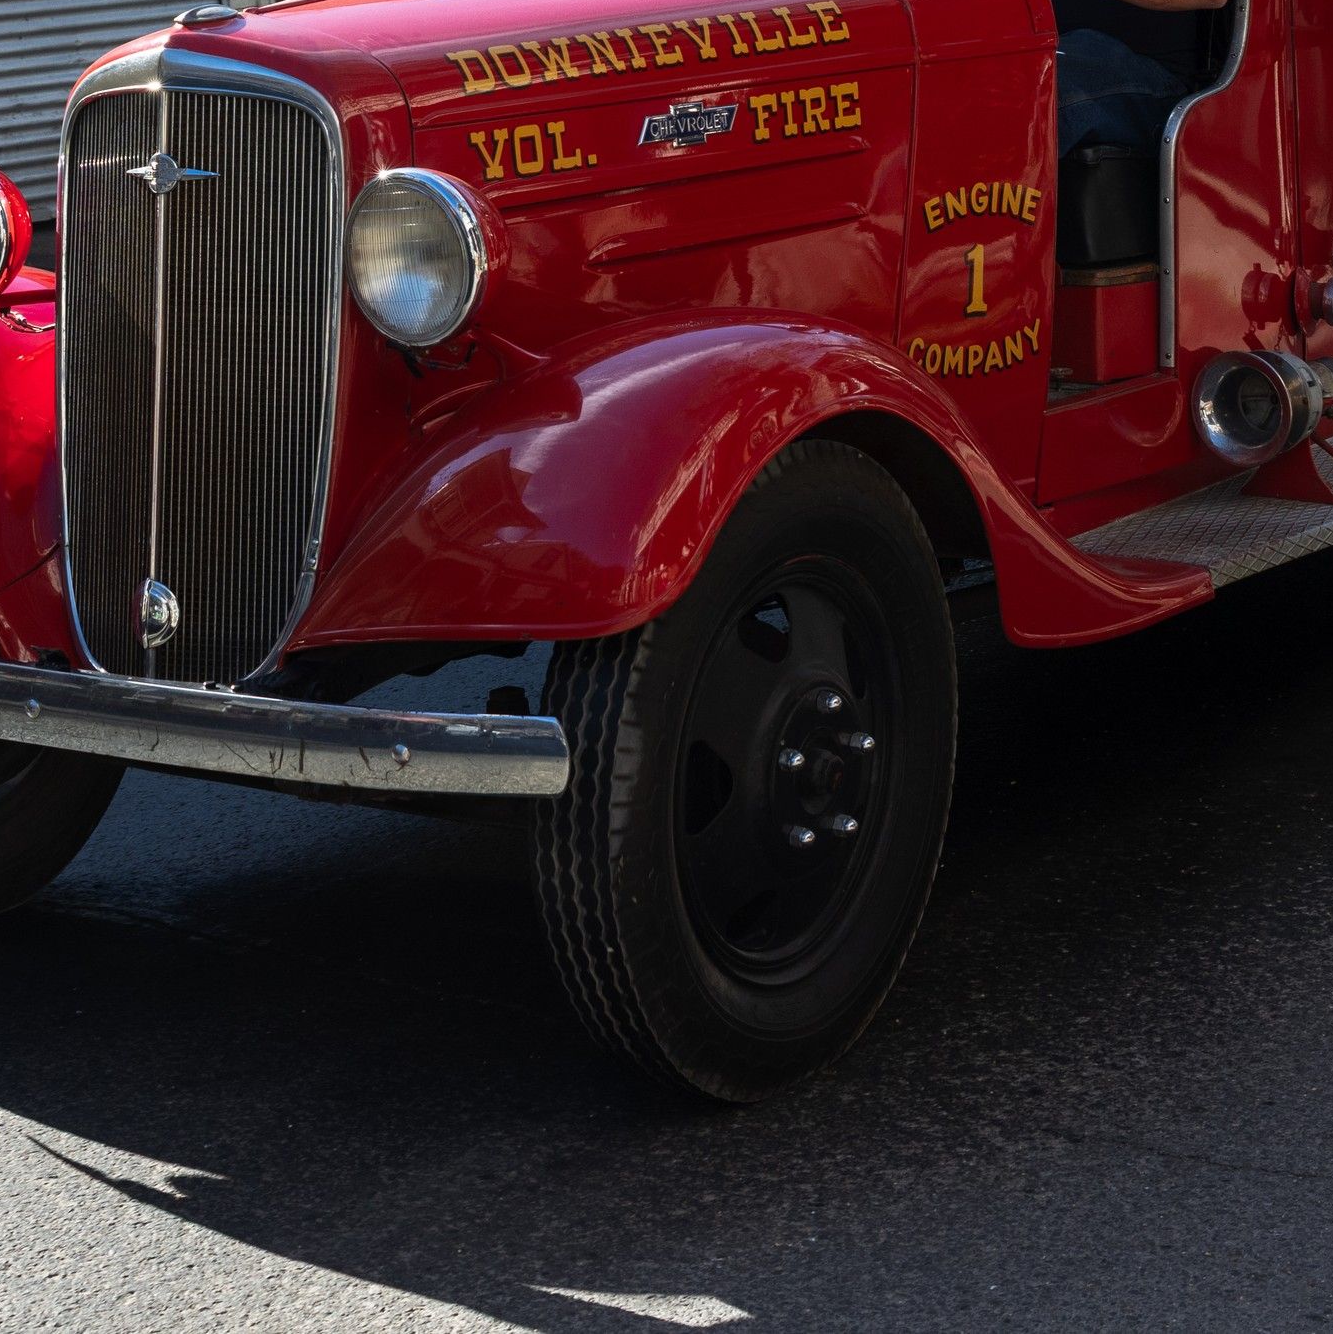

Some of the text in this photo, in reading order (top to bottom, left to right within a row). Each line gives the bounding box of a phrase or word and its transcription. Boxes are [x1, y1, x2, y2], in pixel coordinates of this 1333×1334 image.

[446, 0, 850, 94] DOWNIEVILLE
[470, 82, 863, 179] VOL. FIRE
[649, 112, 729, 137] CHEVROLET
[924, 181, 1042, 230] ENGINE
[966, 243, 988, 314] 1
[908, 318, 1041, 375] COMPANY
